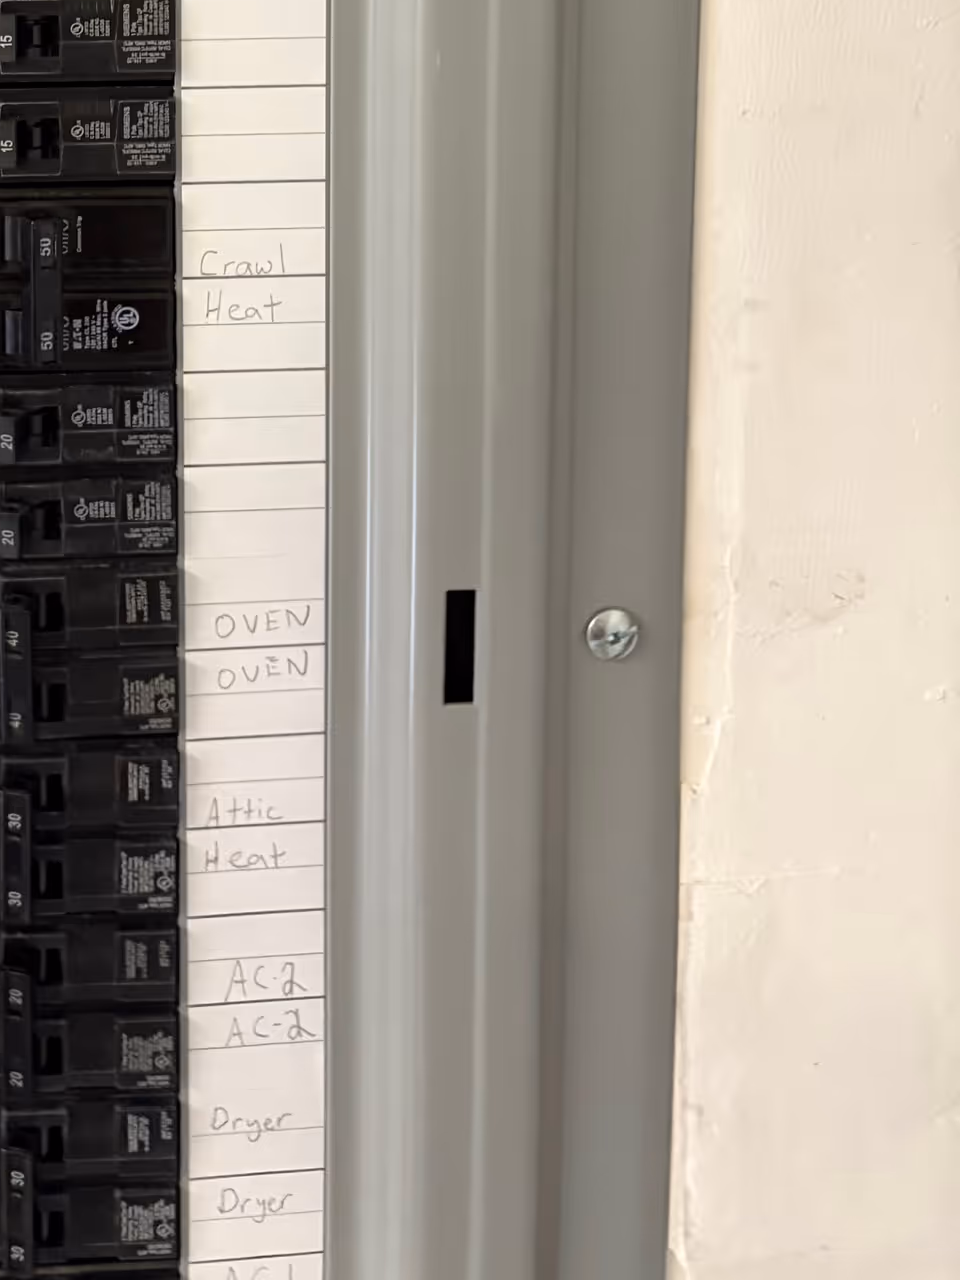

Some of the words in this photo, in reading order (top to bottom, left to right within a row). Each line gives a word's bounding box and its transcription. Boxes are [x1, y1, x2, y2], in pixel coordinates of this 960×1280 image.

[0, 35, 13, 48] 15
[0, 140, 14, 153] 15
[39, 237, 52, 257] 50
[200, 243, 285, 276] Crawl
[205, 289, 282, 323] Heat
[40, 331, 54, 351] 50
[0, 433, 14, 451] 20
[1, 529, 15, 546] 20
[215, 604, 310, 639] OVEN
[217, 649, 308, 690] OVEN
[205, 797, 284, 827] Attic
[204, 841, 286, 872] Heat
[225, 1008, 316, 1047] AC-2
[210, 1106, 292, 1142] Dryer
[217, 1187, 293, 1223] Dryer
